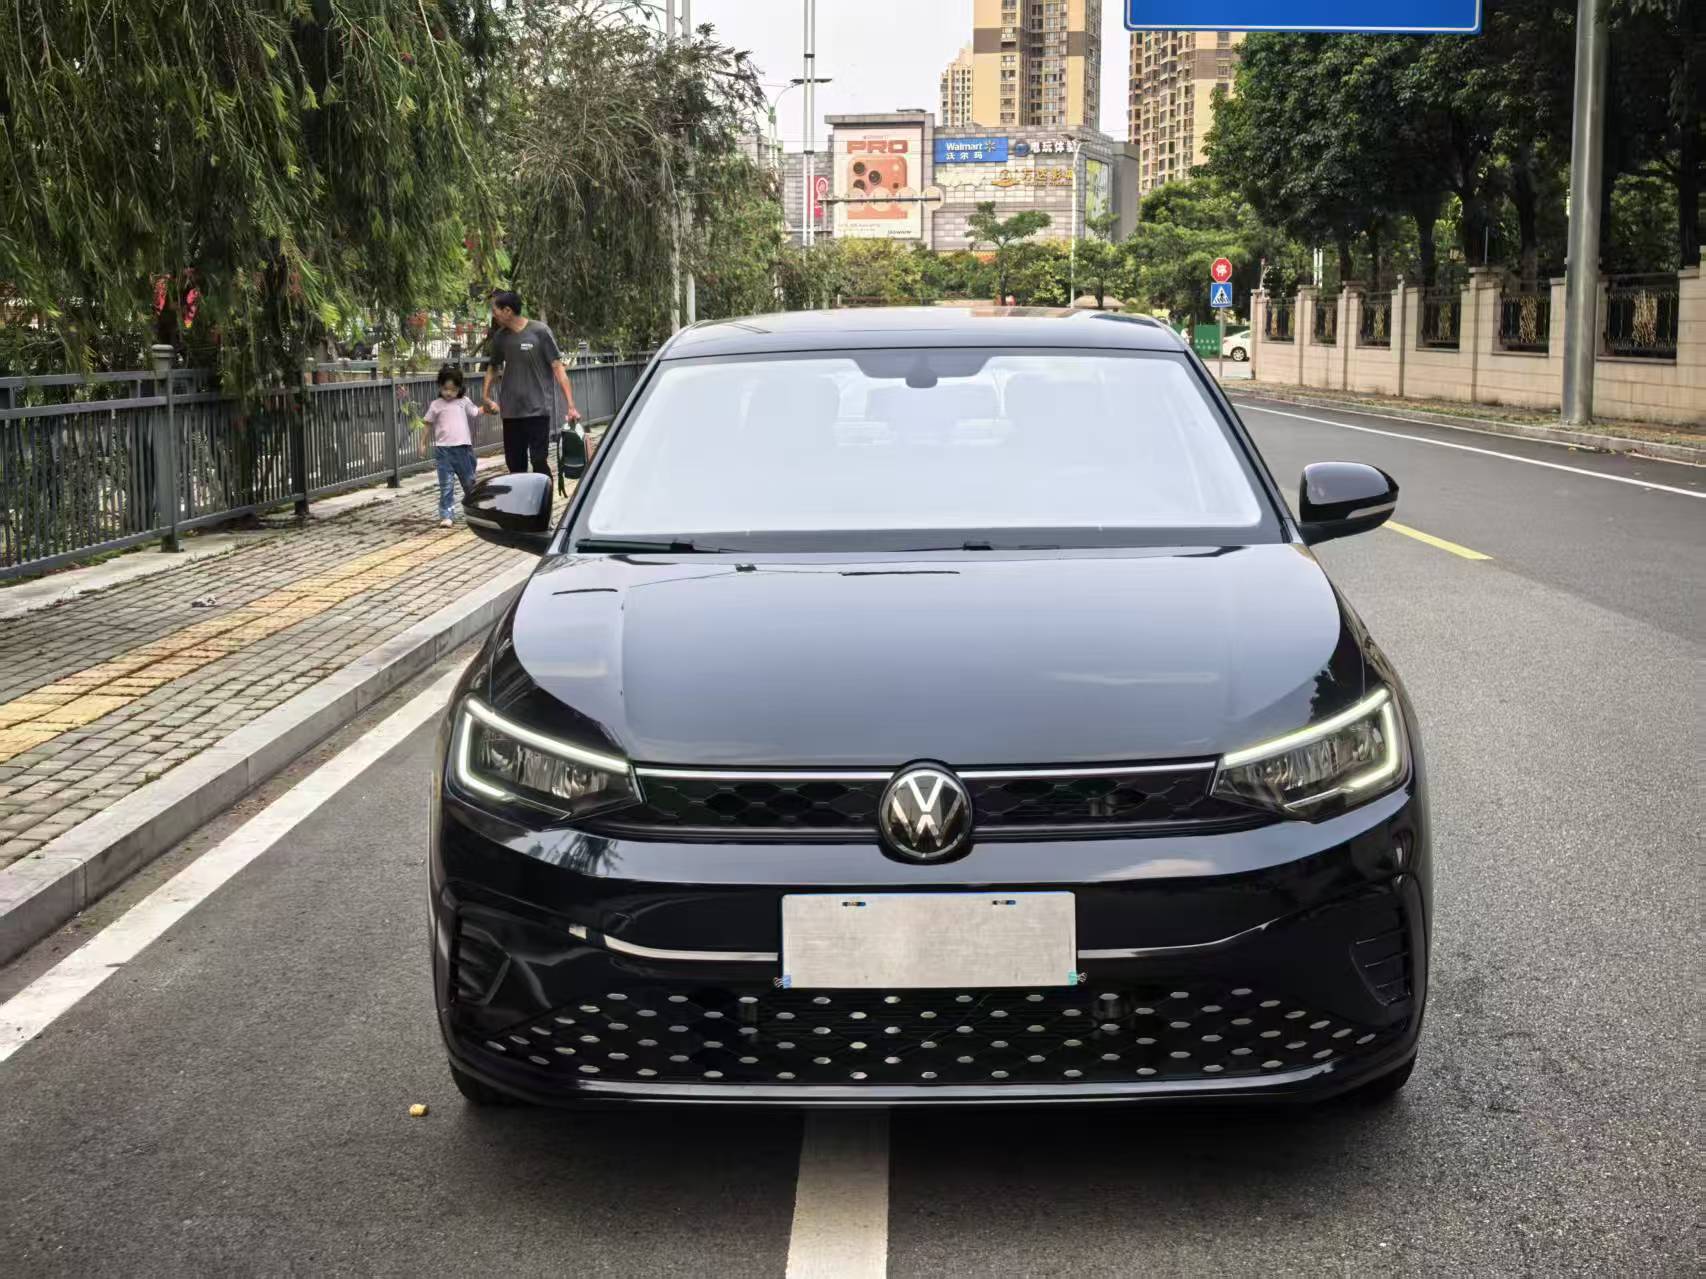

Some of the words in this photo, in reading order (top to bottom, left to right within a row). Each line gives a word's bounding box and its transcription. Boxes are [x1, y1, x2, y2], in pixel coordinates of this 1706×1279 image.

[847, 140, 908, 154] PRO
[946, 142, 982, 151] Walmart
[945, 151, 983, 160] 沃尔玛
